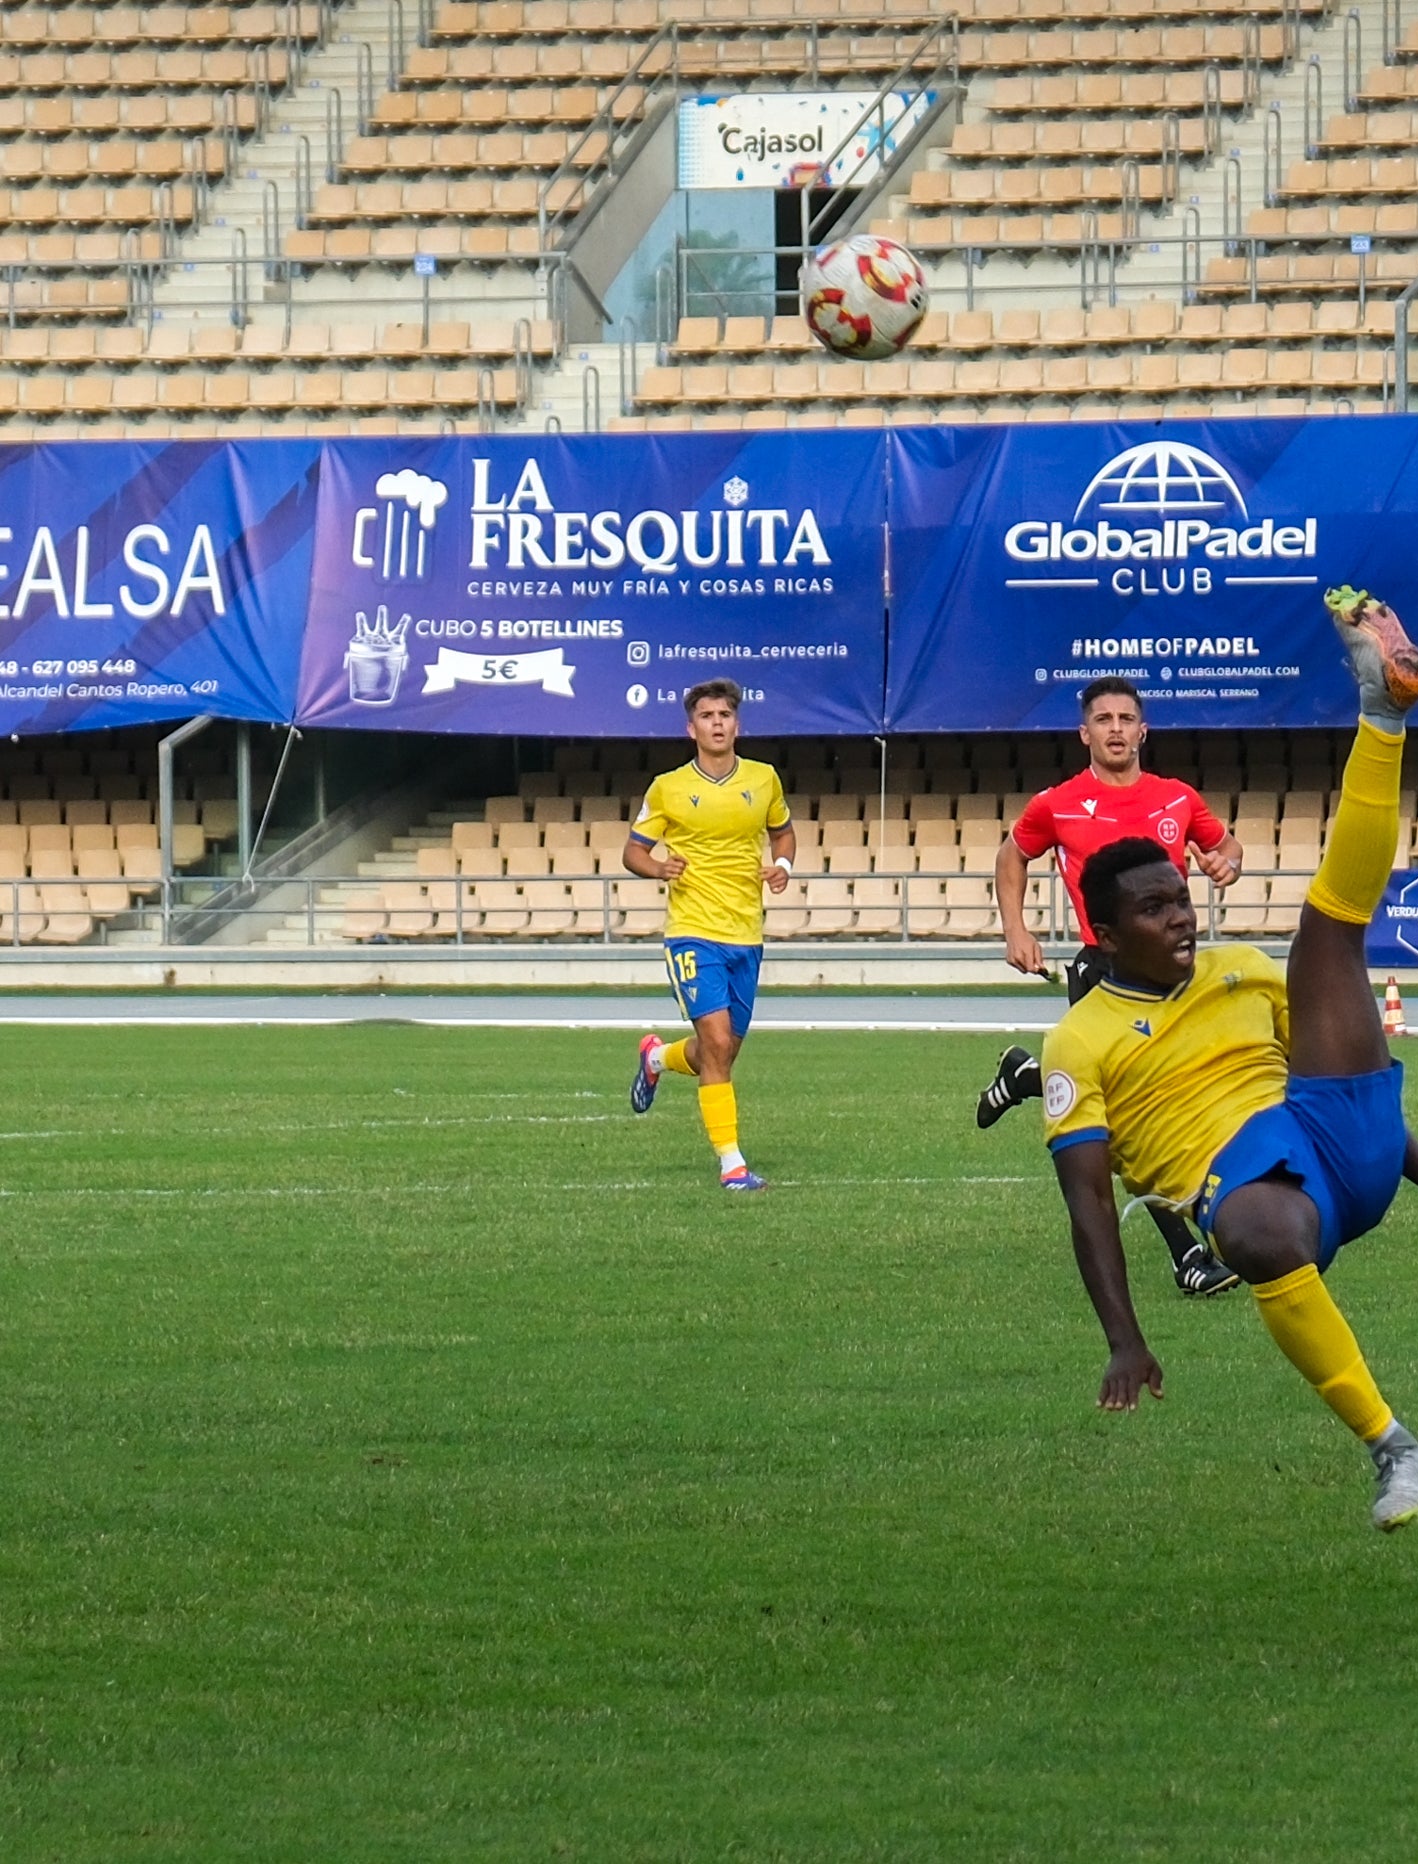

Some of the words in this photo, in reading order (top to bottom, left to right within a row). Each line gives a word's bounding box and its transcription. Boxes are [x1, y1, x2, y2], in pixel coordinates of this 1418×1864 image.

[720, 125, 823, 161] Cajasol
[471, 457, 554, 511] LA
[469, 508, 832, 573] FRESQUITA
[1004, 518, 1317, 560] GlobalPadel
[467, 581, 562, 596] CERVEZA
[572, 580, 613, 596] MUY
[623, 578, 669, 595] FRÍA
[679, 579, 690, 594] Y
[699, 579, 765, 594] COSAS
[774, 578, 834, 593] RICAS
[1112, 567, 1213, 594] CLUB
[415, 619, 477, 636] CUBO
[480, 620, 493, 636] 5
[498, 619, 624, 637] BOTELLINES
[1072, 637, 1260, 656] #HOMEOFPADEL
[32, 660, 64, 674] 627
[67, 660, 98, 673] 095
[101, 659, 135, 673] 448
[481, 659, 519, 680] 5€
[67, 683, 122, 697] Cantos
[127, 681, 188, 698] Ropero,
[190, 680, 218, 693] 401
[657, 688, 677, 701] La
[674, 951, 697, 982] 15
